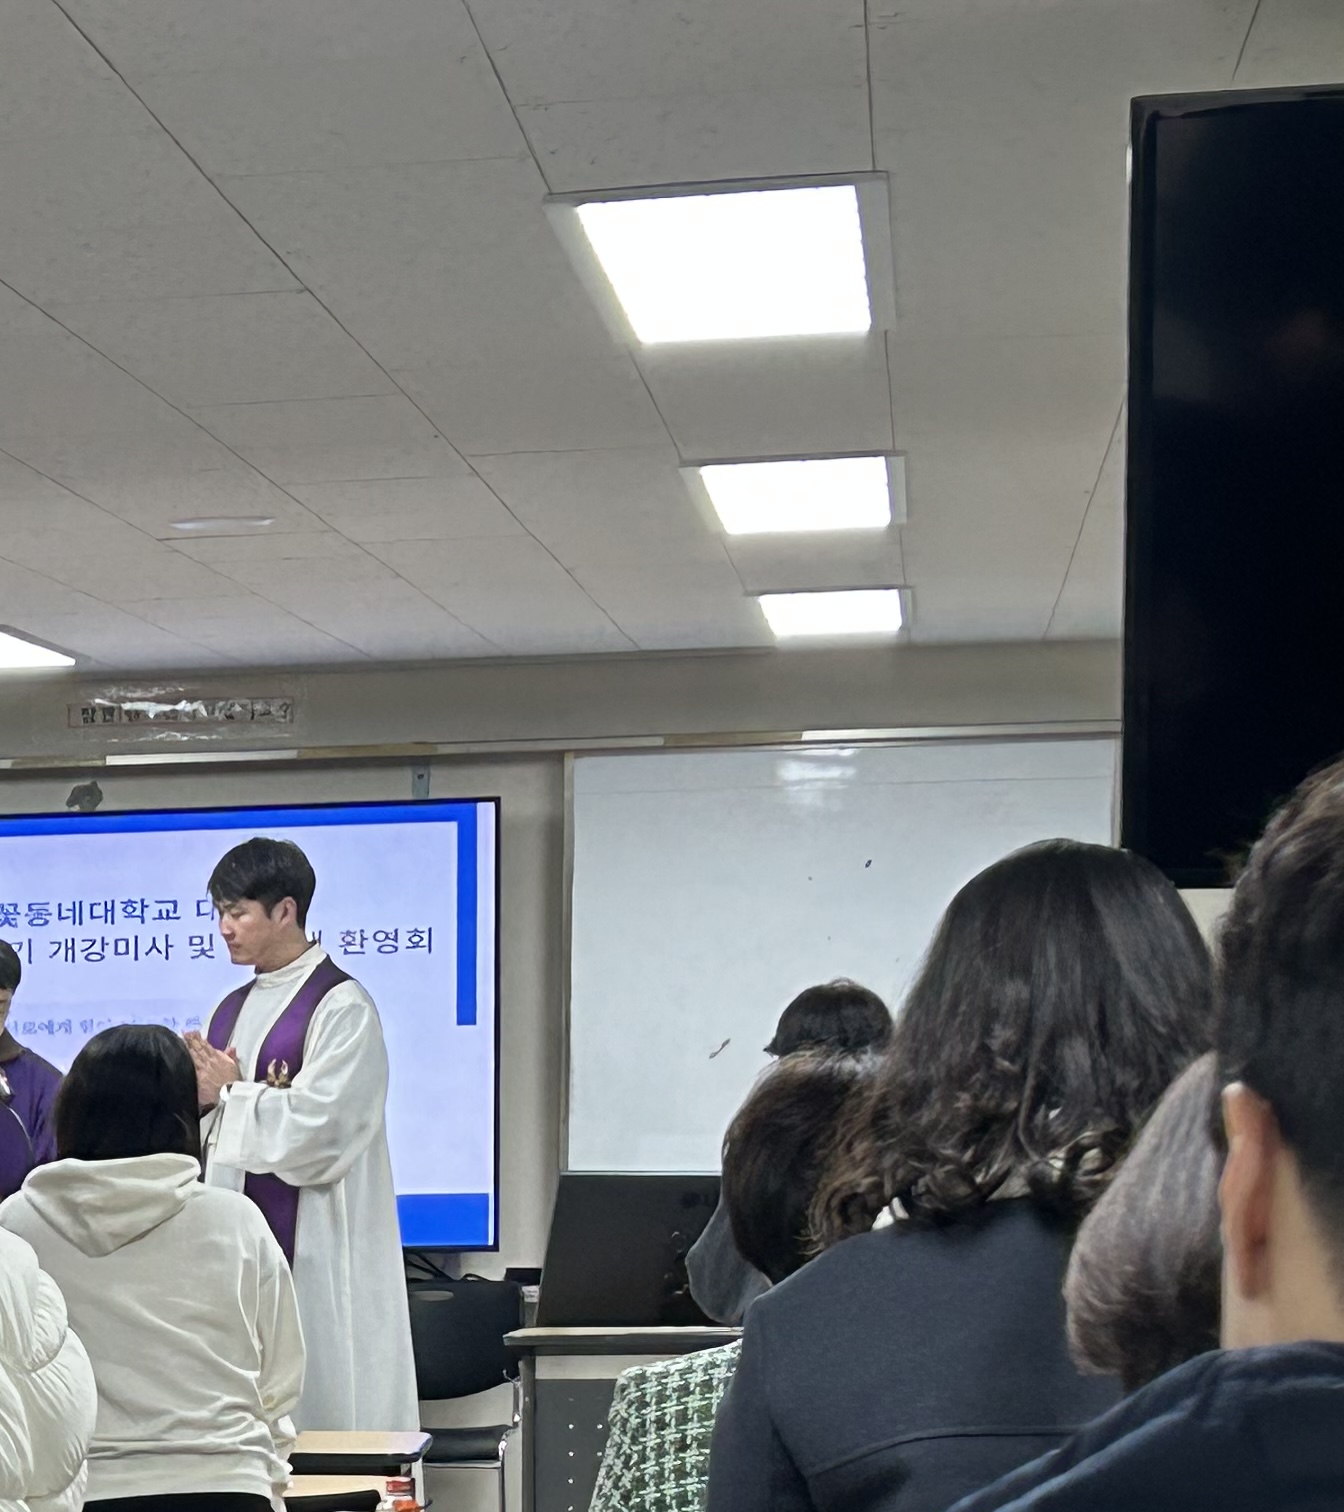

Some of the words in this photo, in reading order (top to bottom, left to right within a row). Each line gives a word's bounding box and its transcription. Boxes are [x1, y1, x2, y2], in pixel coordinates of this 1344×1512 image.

[48, 933, 174, 964] 개강미사
[188, 933, 215, 960] 및
[338, 926, 433, 956] 환영회
